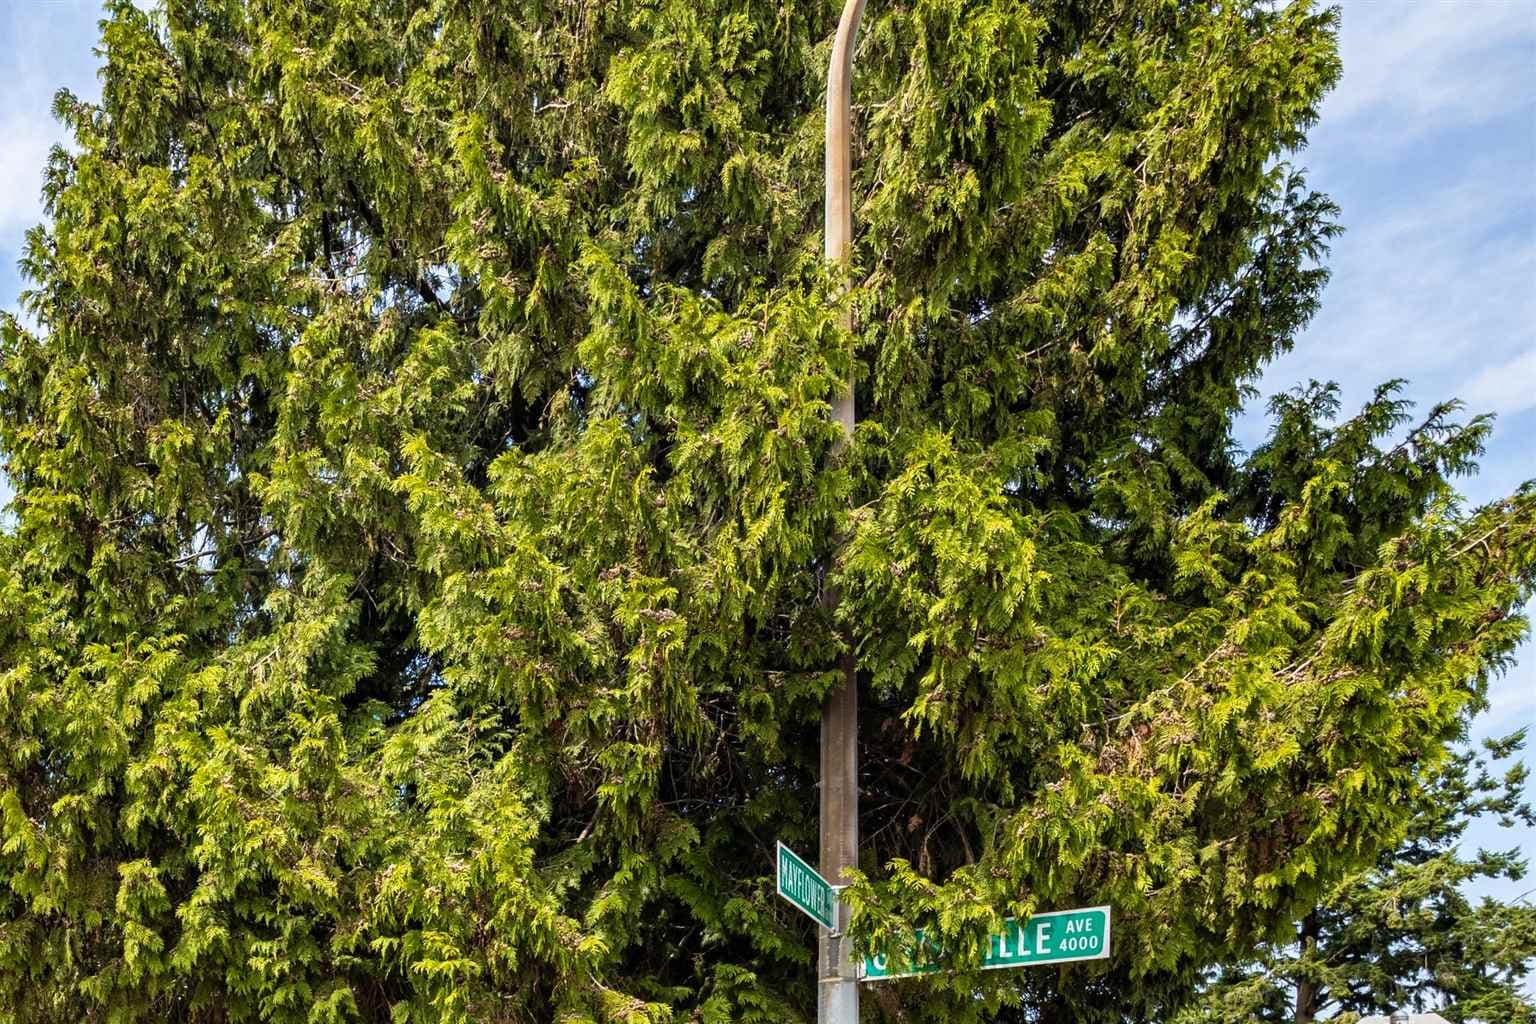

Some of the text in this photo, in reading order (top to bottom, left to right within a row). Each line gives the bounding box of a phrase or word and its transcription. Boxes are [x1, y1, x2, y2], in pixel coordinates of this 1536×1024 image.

[781, 855, 825, 919] MAYFLOWER
[1065, 918, 1093, 934] AVE
[1059, 935, 1098, 951] 4000
